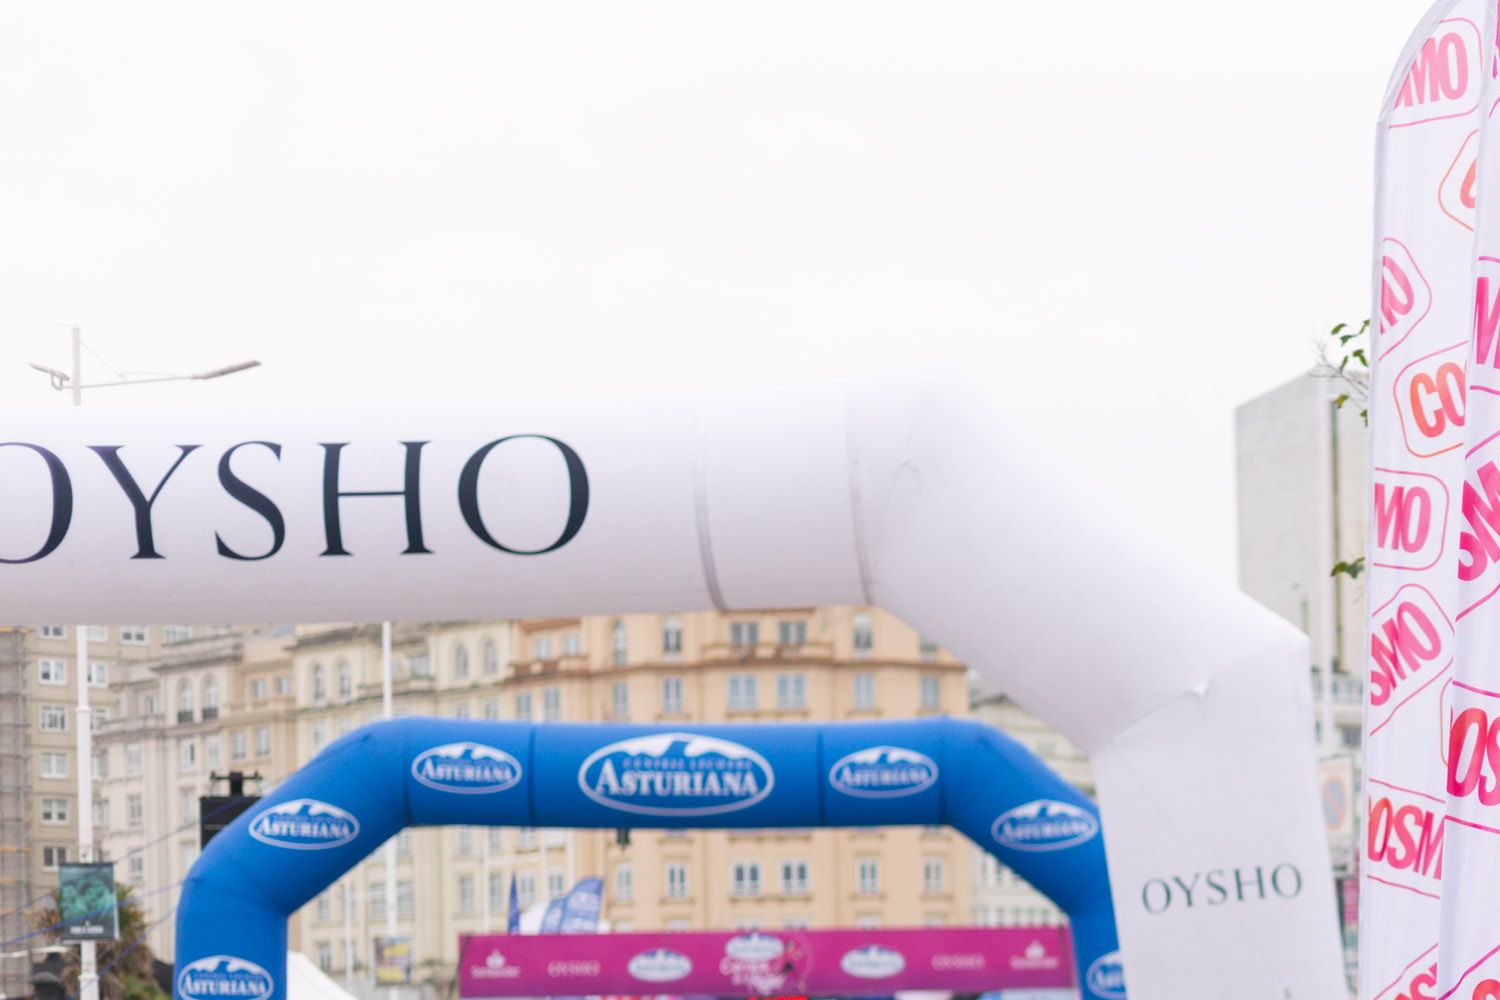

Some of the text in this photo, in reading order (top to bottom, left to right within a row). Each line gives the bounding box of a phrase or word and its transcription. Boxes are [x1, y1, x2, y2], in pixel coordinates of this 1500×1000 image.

[0, 433, 591, 564] OYSHO
[423, 757, 515, 783] ASTURIANA
[595, 757, 760, 798] ASTURIANA
[260, 814, 352, 839] ASTURIANA
[1141, 862, 1304, 916] OYSHO
[183, 973, 267, 997] ASTURIANA
